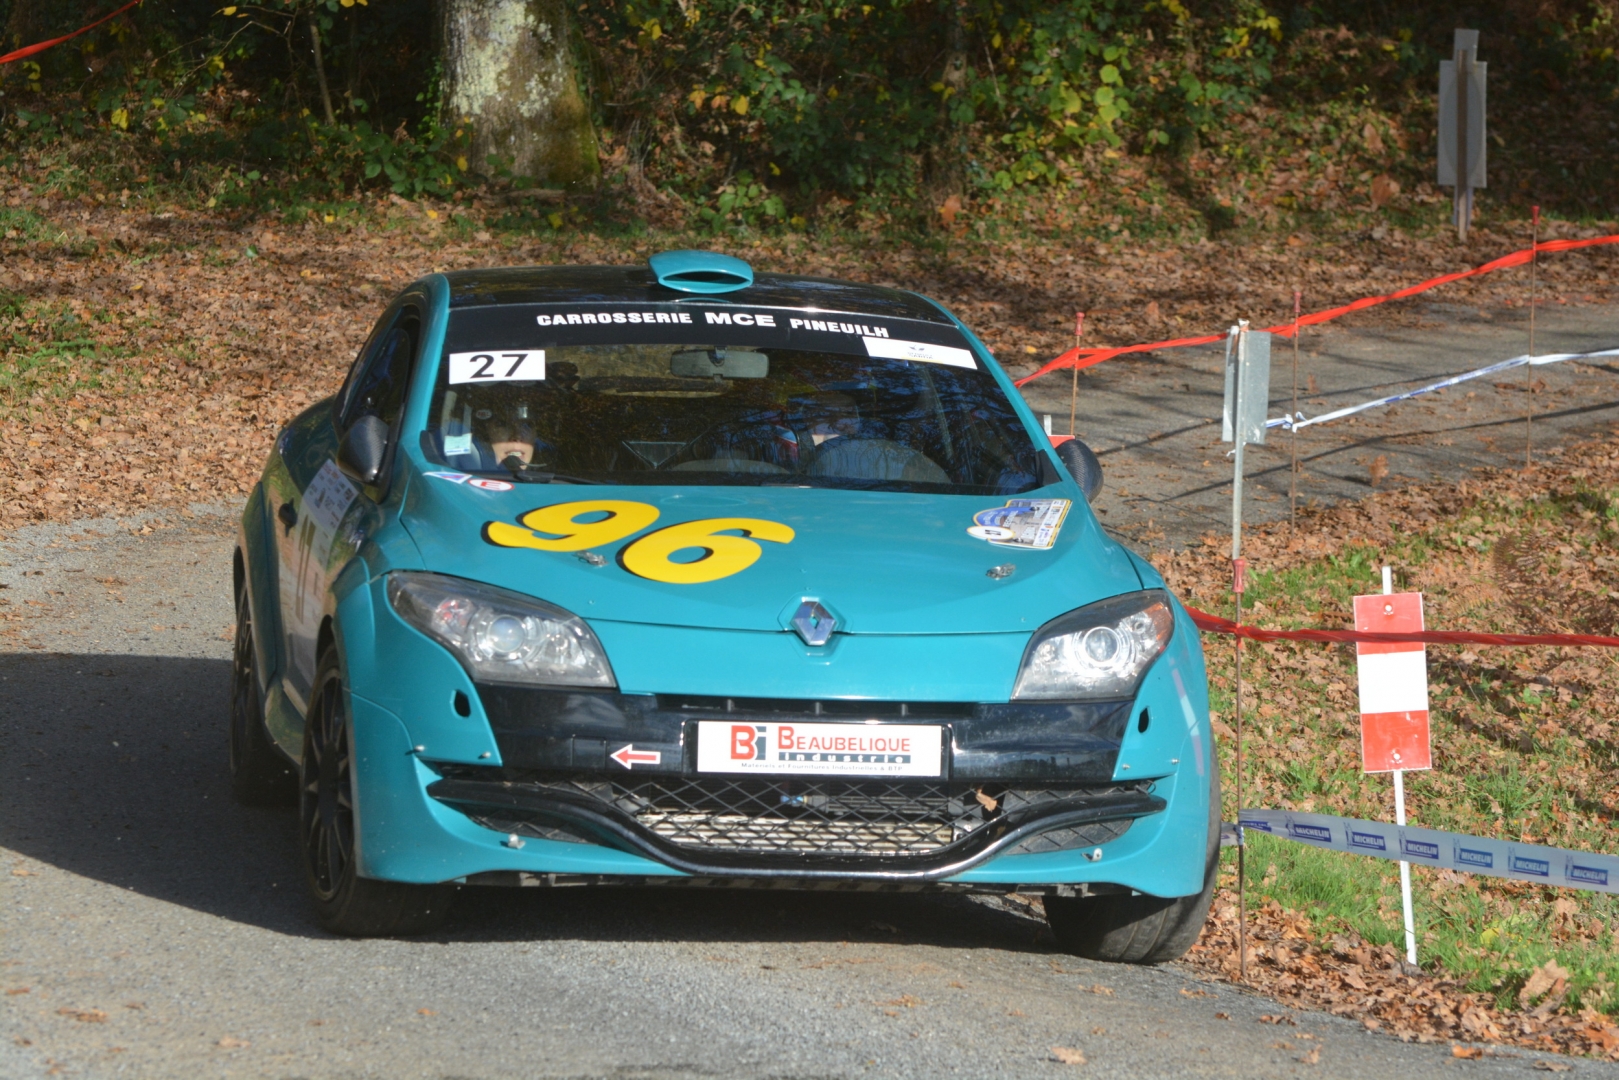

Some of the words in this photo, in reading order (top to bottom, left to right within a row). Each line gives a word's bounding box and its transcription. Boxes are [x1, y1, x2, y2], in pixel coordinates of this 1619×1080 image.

[536, 312, 693, 326] CARROSSERIE
[704, 312, 776, 328] MCE
[789, 318, 890, 338] PINEUILH
[469, 353, 529, 379] 27
[480, 499, 796, 585] 96
[784, 752, 904, 763] industrie
[1295, 826, 1330, 839] MICHELIN
[1354, 834, 1385, 847] MICHELIN
[1407, 842, 1438, 855] MICHELIN
[1461, 851, 1492, 864] MICHELIN
[1515, 859, 1548, 873] MICHELIN
[1573, 867, 1607, 881] MICHELIN
